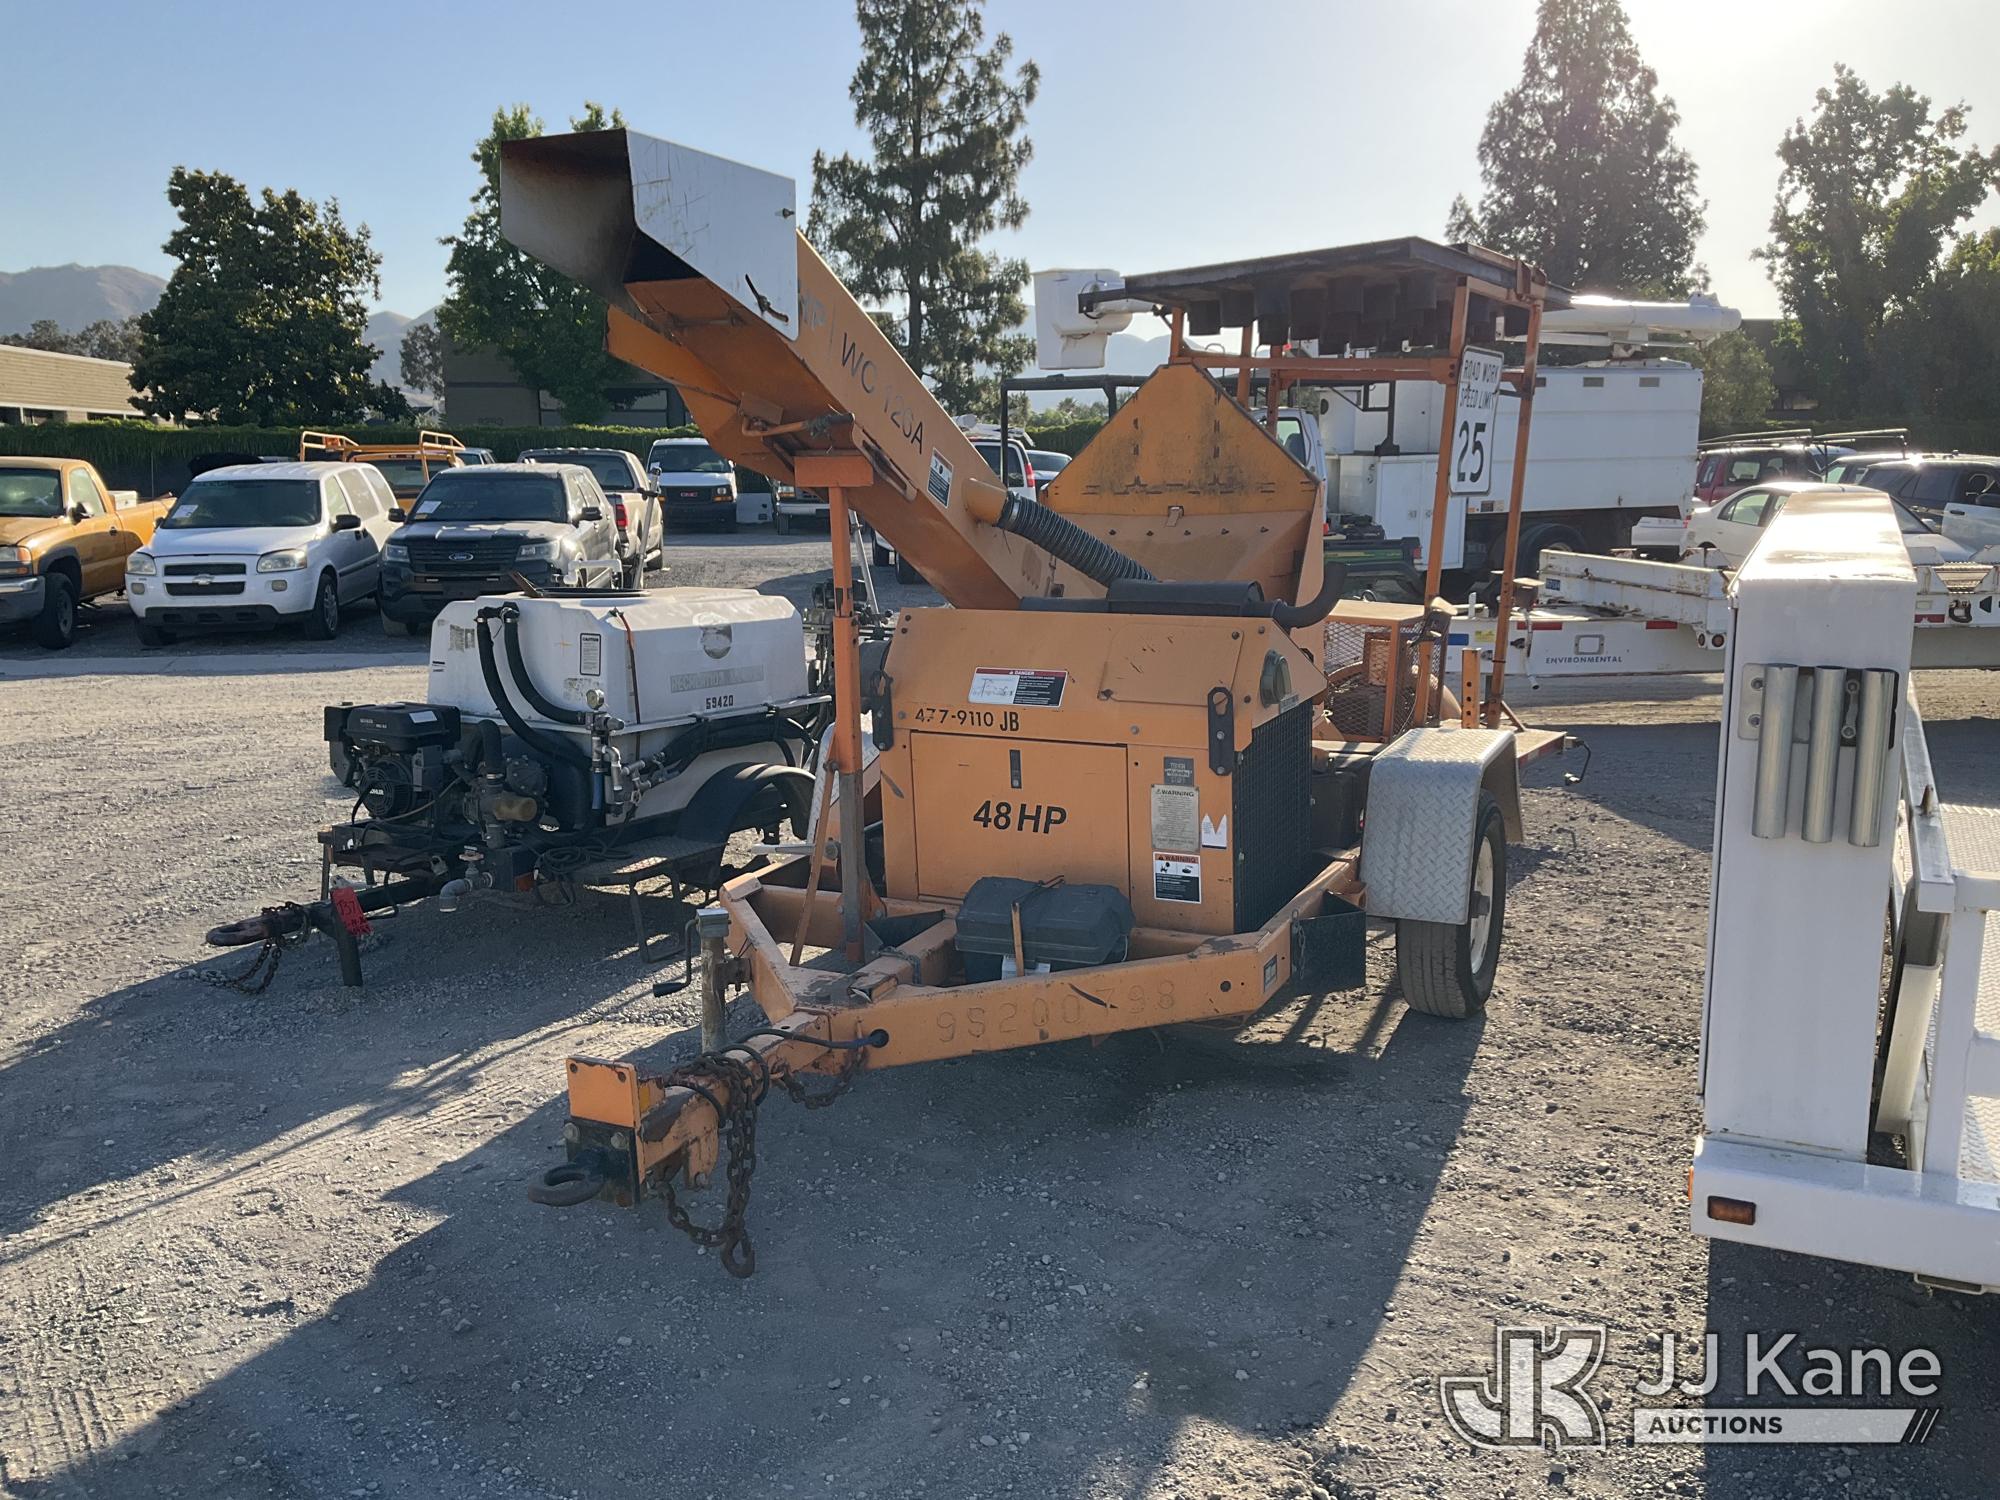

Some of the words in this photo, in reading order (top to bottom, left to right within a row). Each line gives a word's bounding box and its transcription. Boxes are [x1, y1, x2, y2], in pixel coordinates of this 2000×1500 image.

[1463, 359, 1481, 381] ROAD
[1482, 362, 1500, 384] WORK
[1460, 387, 1479, 408] SPEED
[1457, 420, 1487, 483] 25
[1545, 655, 1622, 664] ENVIRONMENTAL
[705, 695, 734, 710] 59420
[915, 707, 994, 728] 477-9110
[999, 711, 1020, 732] JB
[1161, 788, 1195, 798] WARNING
[973, 799, 1012, 830] 48
[1017, 803, 1067, 834] HP
[1164, 854, 1199, 863] WARNING
